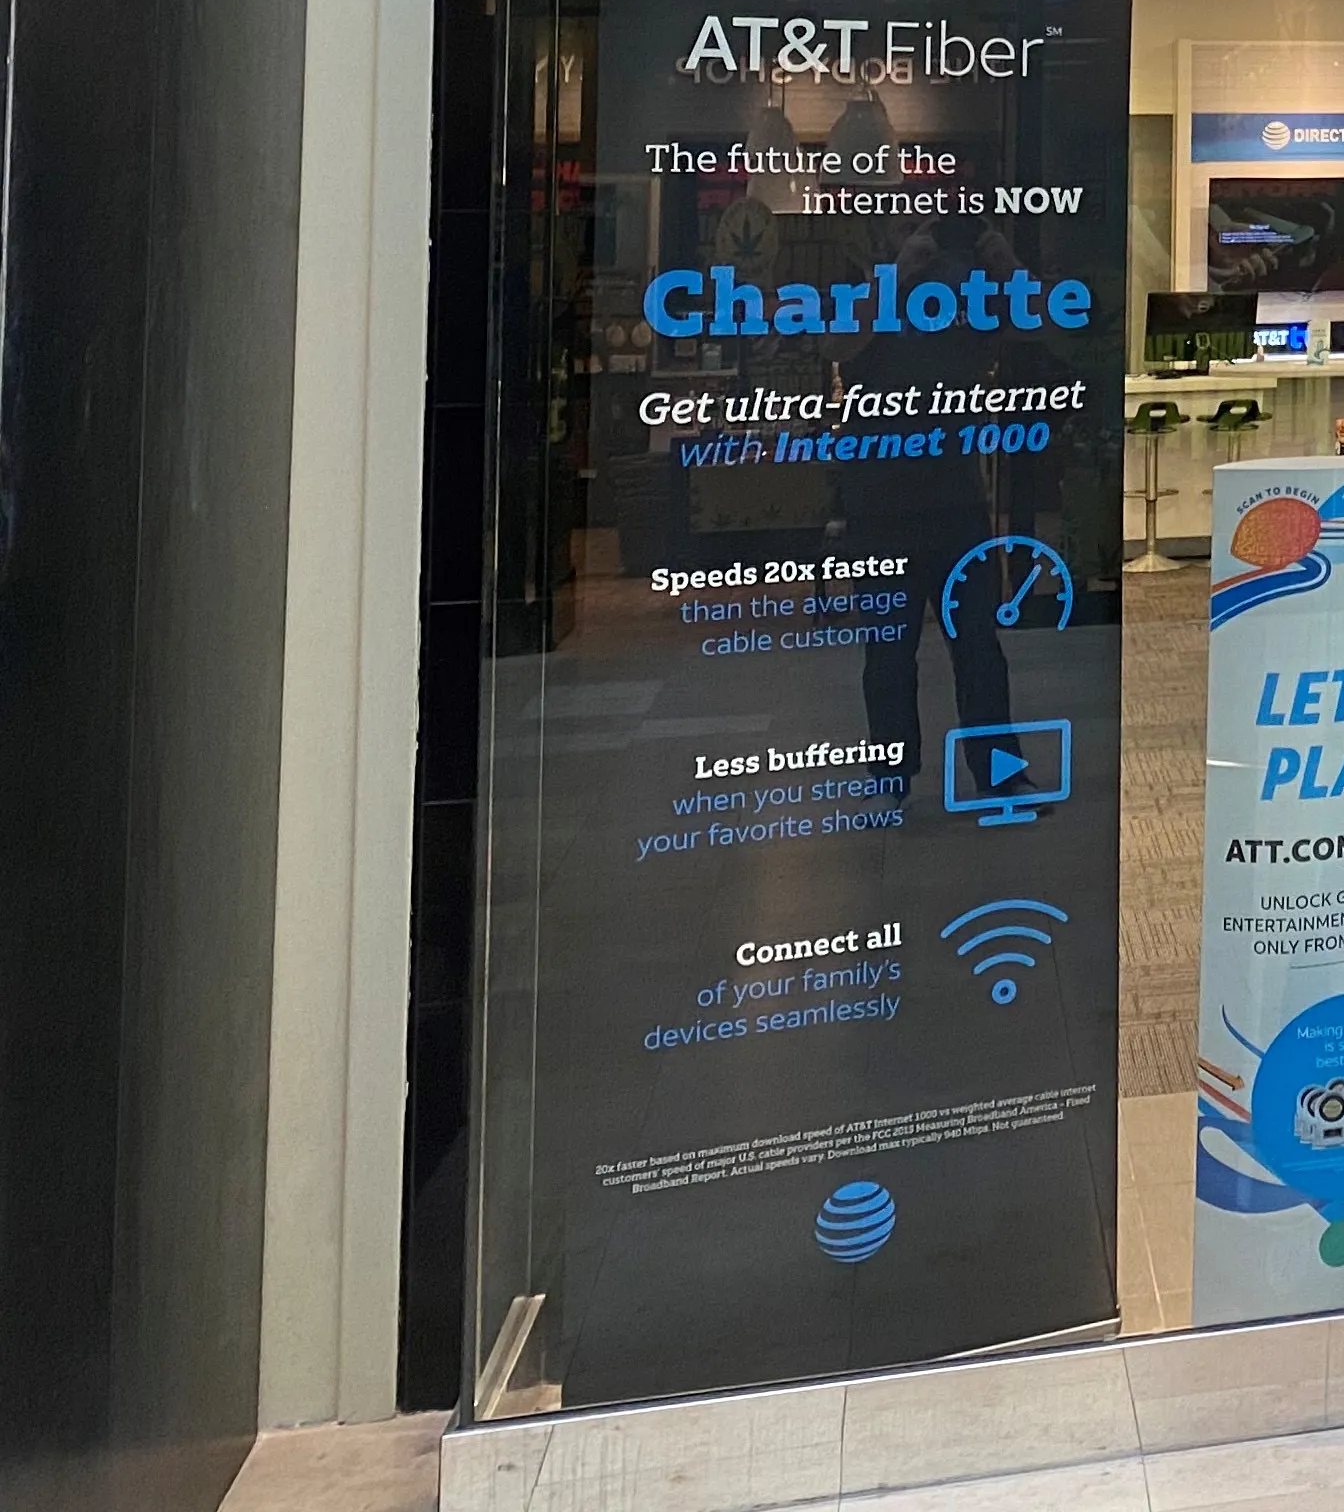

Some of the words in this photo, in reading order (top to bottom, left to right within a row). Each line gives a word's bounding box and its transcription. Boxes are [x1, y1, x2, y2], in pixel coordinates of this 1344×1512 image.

[685, 15, 868, 75] AT&T
[886, 20, 1044, 78] Fiber
[646, 143, 717, 174] The
[727, 144, 842, 175] future
[852, 144, 889, 175] of
[898, 145, 956, 175] the
[802, 187, 948, 215] internet
[958, 187, 985, 215] is
[993, 186, 1083, 215] NOW
[642, 263, 1092, 338] Charlotte
[638, 390, 714, 426] Get
[725, 384, 918, 427] ultra-fast
[929, 381, 1086, 415] internet
[680, 432, 762, 468] with
[773, 427, 943, 464] Internet
[957, 422, 1050, 456] 1000
[1236, 490, 1264, 516] SCAN
[1266, 486, 1281, 498] TO
[1285, 486, 1321, 506] BEGIN
[651, 562, 757, 596] Speeds
[763, 560, 816, 584] 20x
[822, 555, 909, 581] faster
[681, 599, 742, 624] than
[750, 594, 795, 618] the
[802, 591, 908, 622] average
[701, 629, 772, 656] cable
[780, 621, 908, 650] customer
[695, 755, 760, 780] Less
[767, 740, 905, 773] buffering
[672, 788, 745, 817] when
[754, 785, 803, 814] you
[810, 775, 903, 802] stream
[636, 830, 699, 862] your
[708, 815, 813, 848] favorite
[821, 807, 903, 834] shows
[1261, 892, 1332, 911] UNLOCK
[735, 933, 859, 967] Connect
[866, 922, 902, 949] all
[1254, 939, 1299, 955] ONLY
[697, 983, 728, 1008] of
[732, 976, 796, 1010] your
[802, 958, 901, 996] family's
[644, 1016, 747, 1051] devices
[755, 994, 901, 1035] seamlessly
[1297, 1025, 1343, 1040] Making
[1316, 1054, 1344, 1069] best
[1324, 1041, 1335, 1052] is
[834, 1124, 845, 1136] of
[694, 1159, 706, 1171] of
[854, 1133, 871, 1144] the
